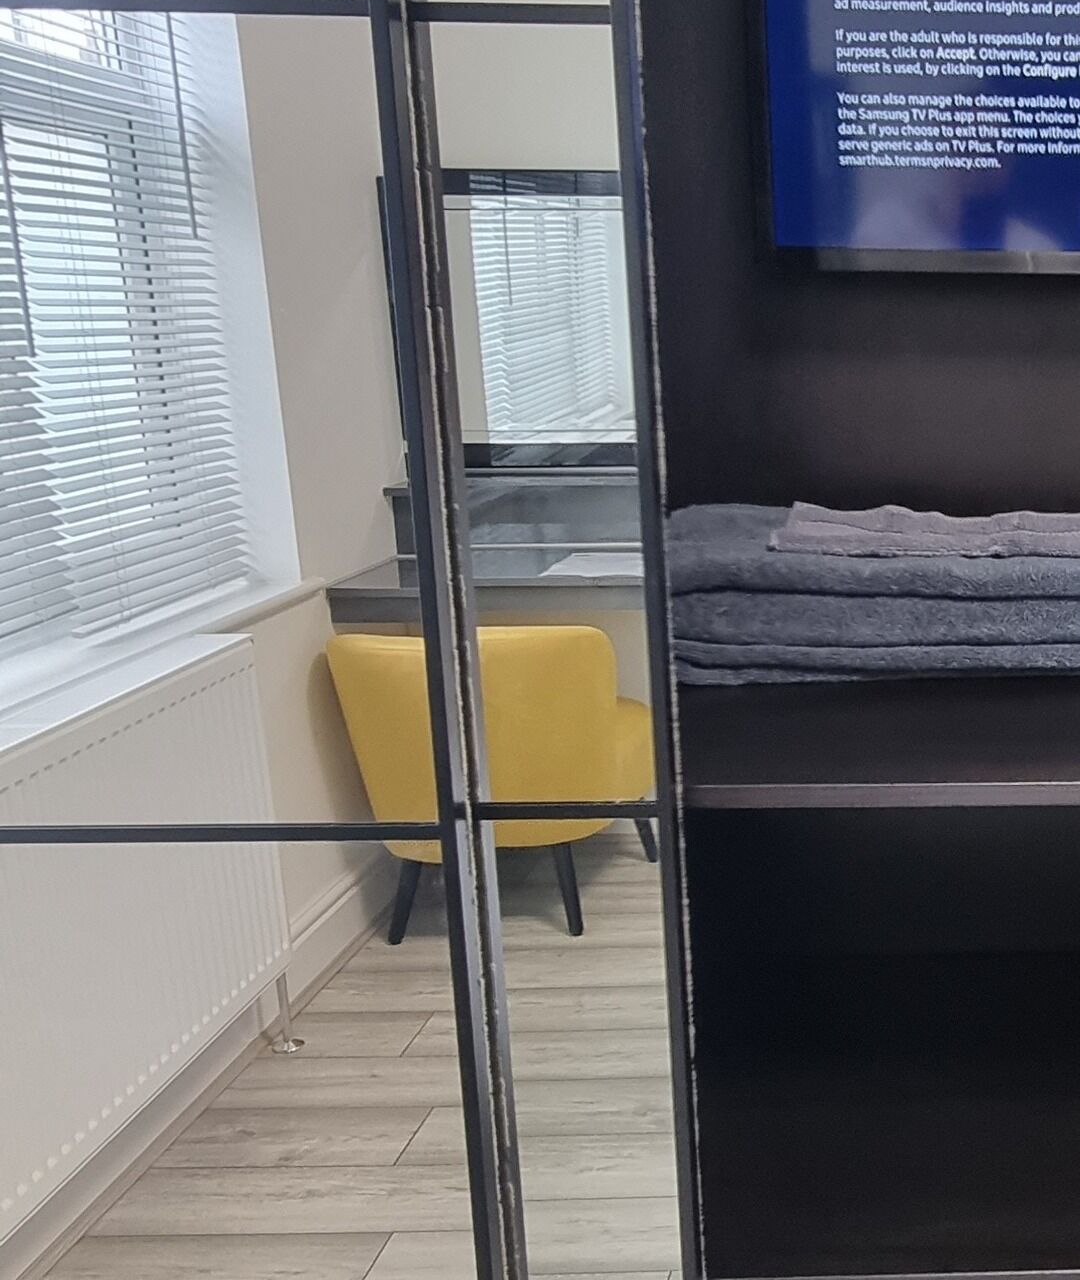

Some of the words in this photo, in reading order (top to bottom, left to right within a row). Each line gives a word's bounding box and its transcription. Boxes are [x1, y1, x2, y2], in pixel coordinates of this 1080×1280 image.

[1031, 0, 1052, 14] and
[835, 27, 843, 42] If
[845, 31, 866, 46] you
[868, 31, 887, 43] are
[889, 28, 908, 43] the
[909, 29, 939, 44] adult
[941, 29, 965, 44] who
[967, 30, 977, 44] is
[979, 30, 1043, 49] responsible
[1045, 31, 1061, 46] for
[835, 59, 880, 74] interest
[882, 59, 891, 74] is
[893, 60, 923, 77] used,
[925, 60, 939, 79] by
[940, 61, 983, 79] clicking
[985, 64, 1000, 76] on
[1001, 62, 1020, 77] the
[1022, 62, 1077, 81] Configure
[838, 139, 869, 151] serve
[870, 137, 912, 155] generic
[913, 138, 933, 152] ads
[935, 141, 949, 152] on
[951, 138, 966, 153] TV
[967, 139, 994, 153] Plus.
[996, 139, 1014, 153] For
[1016, 142, 1045, 154] more
